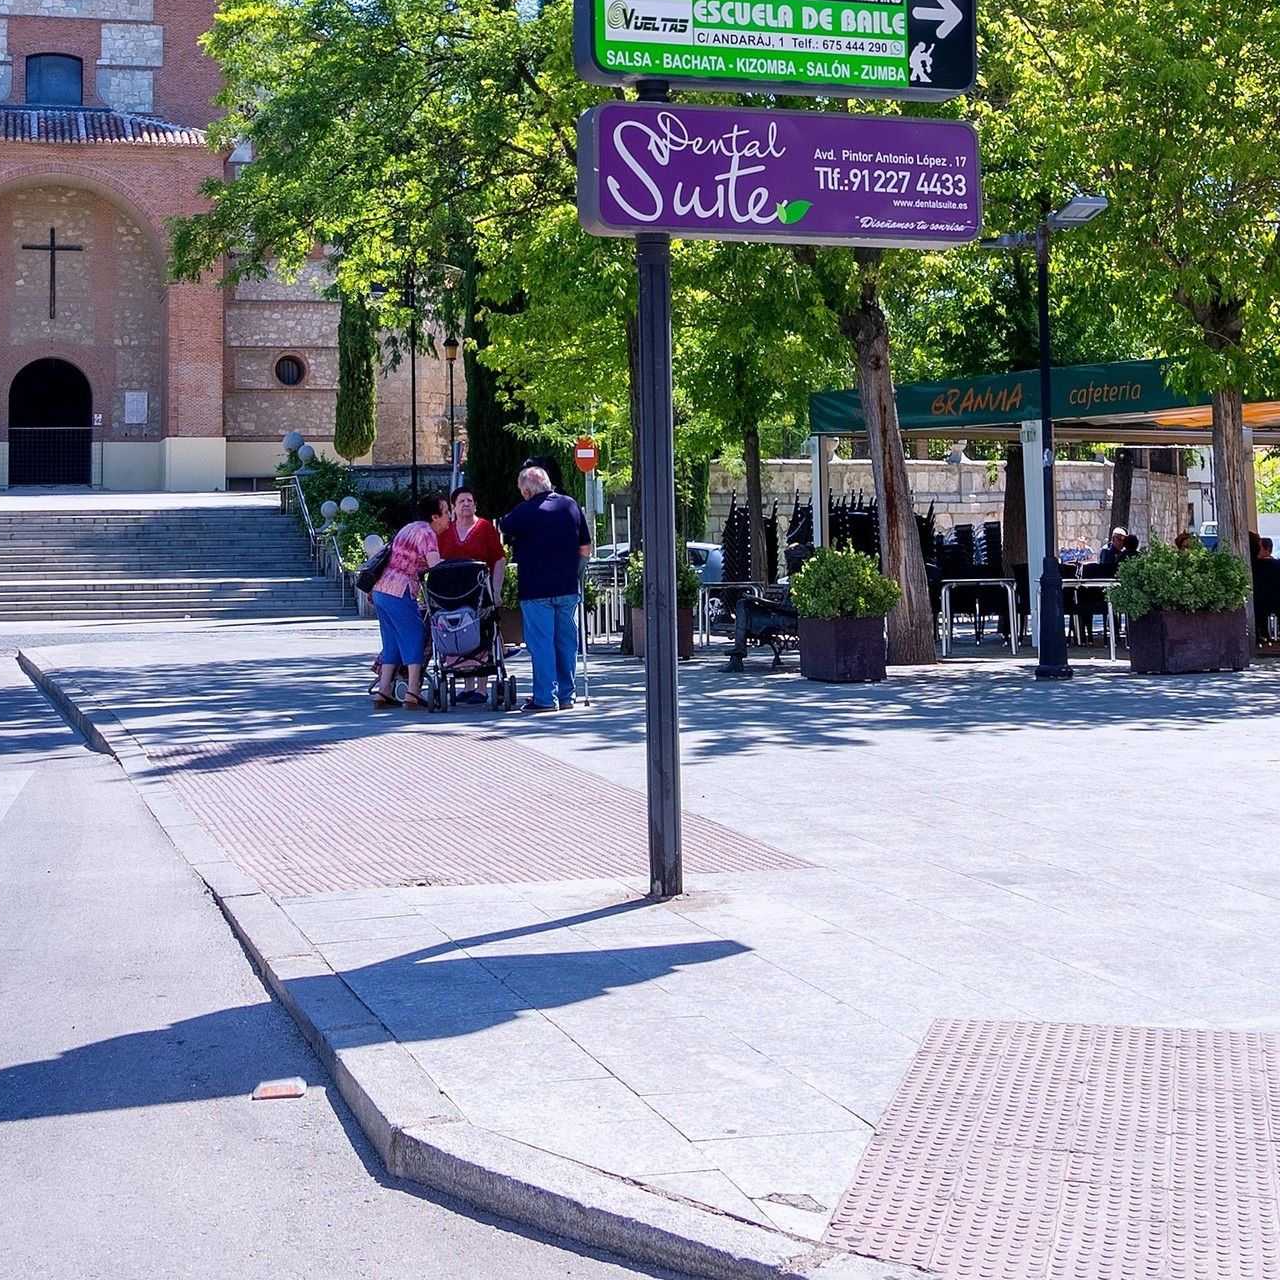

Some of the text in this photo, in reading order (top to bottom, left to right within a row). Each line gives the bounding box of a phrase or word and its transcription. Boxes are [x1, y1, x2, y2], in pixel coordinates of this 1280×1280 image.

[693, 0, 905, 36] ESCUELA DE BAILE
[697, 32, 709, 44] C/
[778, 37, 784, 47] 1
[792, 37, 819, 49] Telf.:
[822, 39, 842, 51] 675
[845, 40, 865, 52] 444
[868, 41, 888, 53] 290
[606, 49, 652, 67] SALSA
[663, 53, 726, 71] BACHATA
[736, 58, 796, 75] KIZOMBA
[806, 60, 851, 79] SALÓN
[861, 64, 906, 81] ZUMBA
[656, 111, 786, 158] Dental
[606, 120, 788, 224] Suite
[813, 149, 836, 161] Avd.
[842, 150, 873, 163] Pintor
[875, 151, 914, 165] Antonio
[955, 156, 967, 168] 17
[873, 169, 910, 194] 227
[916, 172, 967, 196] 4433
[892, 198, 968, 210] www.dentalsuite.es
[916, 220, 929, 230] tu
